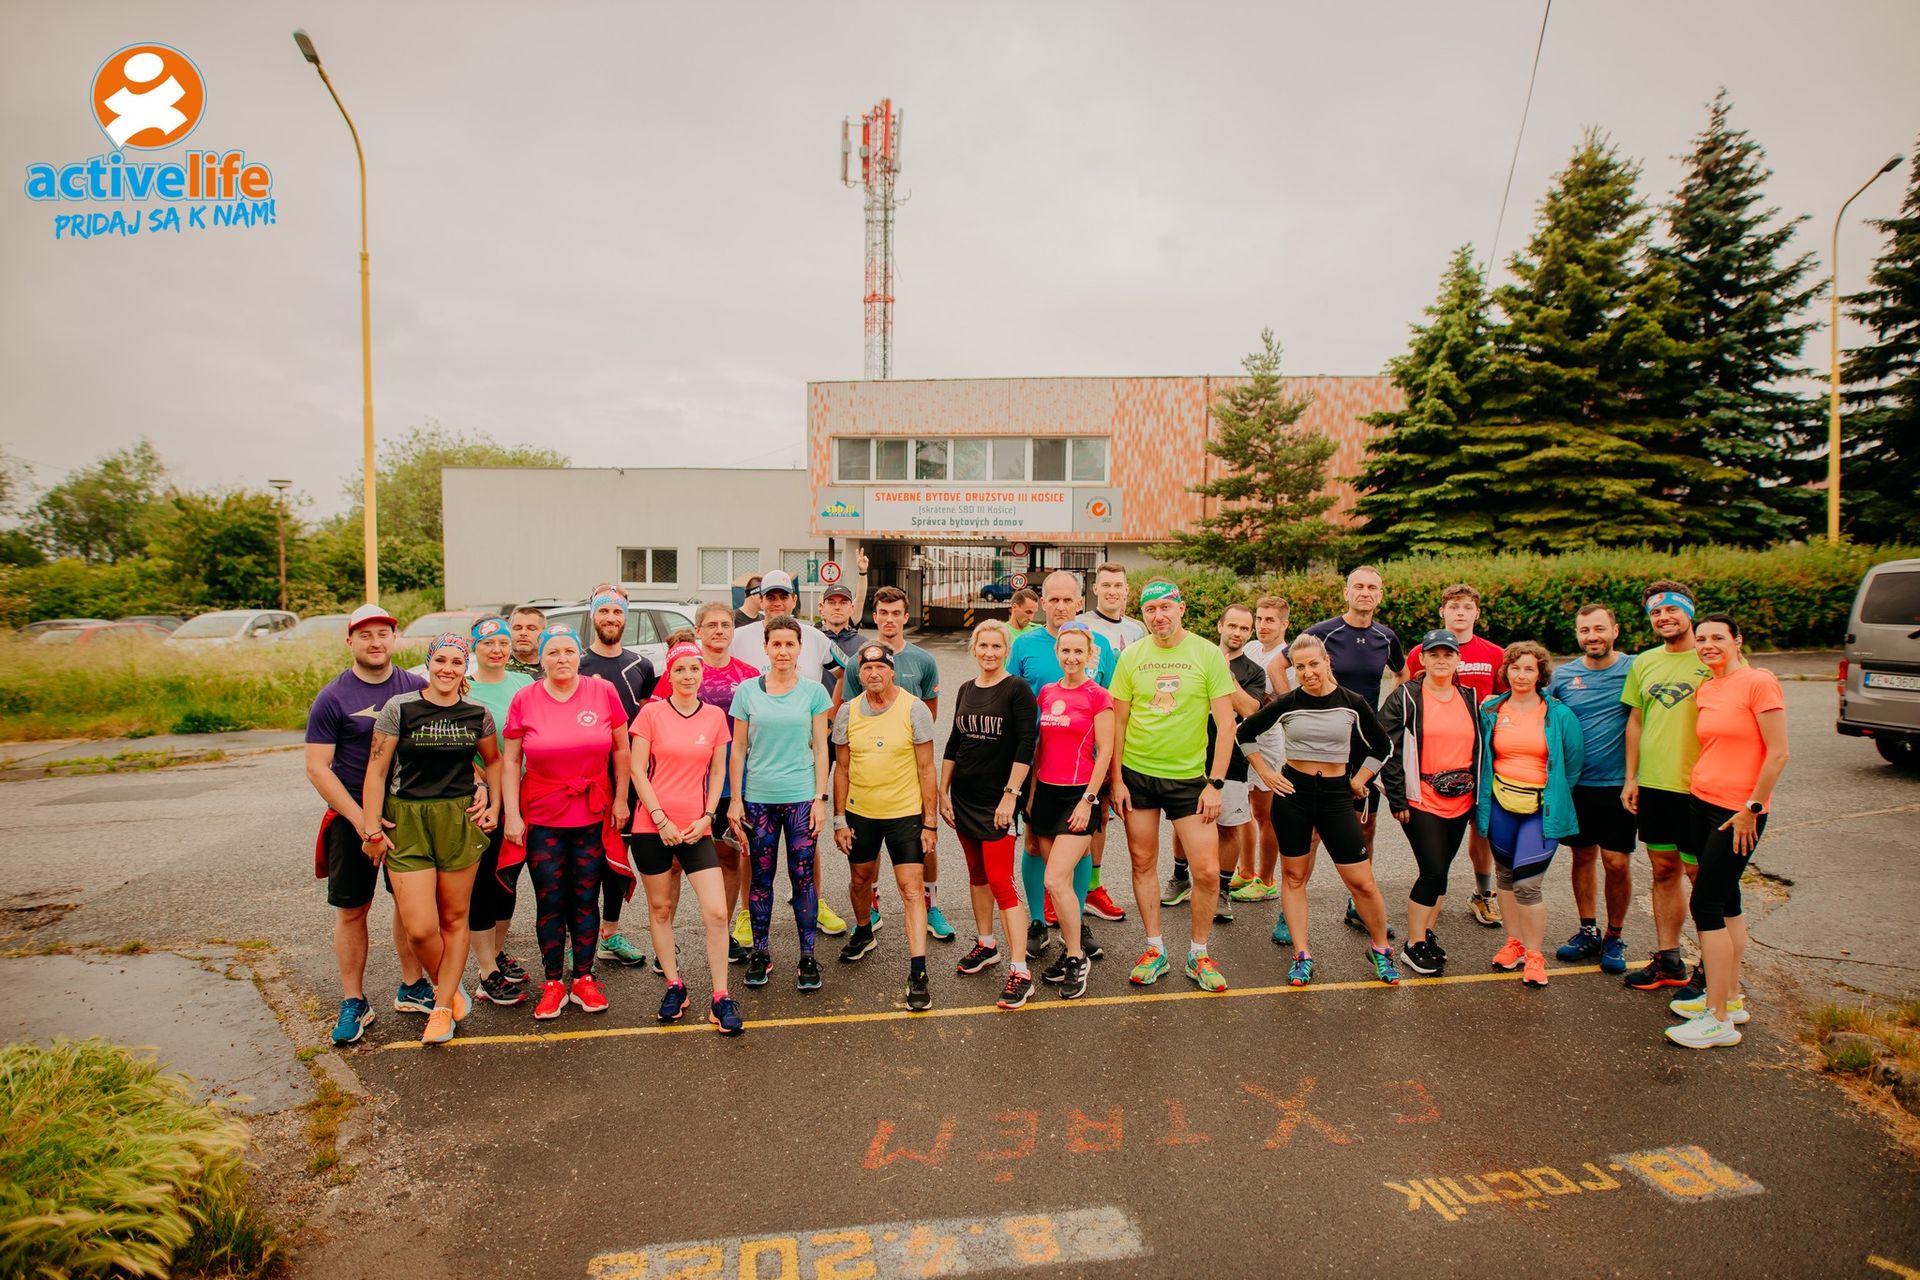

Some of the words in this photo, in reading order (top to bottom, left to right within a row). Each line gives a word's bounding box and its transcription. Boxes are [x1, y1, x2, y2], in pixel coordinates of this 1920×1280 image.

[1018, 493, 1028, 502] III
[958, 505, 974, 514] SBD
[911, 517, 946, 528] Správca
[950, 517, 989, 528] bytových
[993, 517, 1024, 526] domov
[1014, 576, 1024, 585] 20
[968, 714, 978, 732] IN
[980, 715, 1003, 735] LOVE
